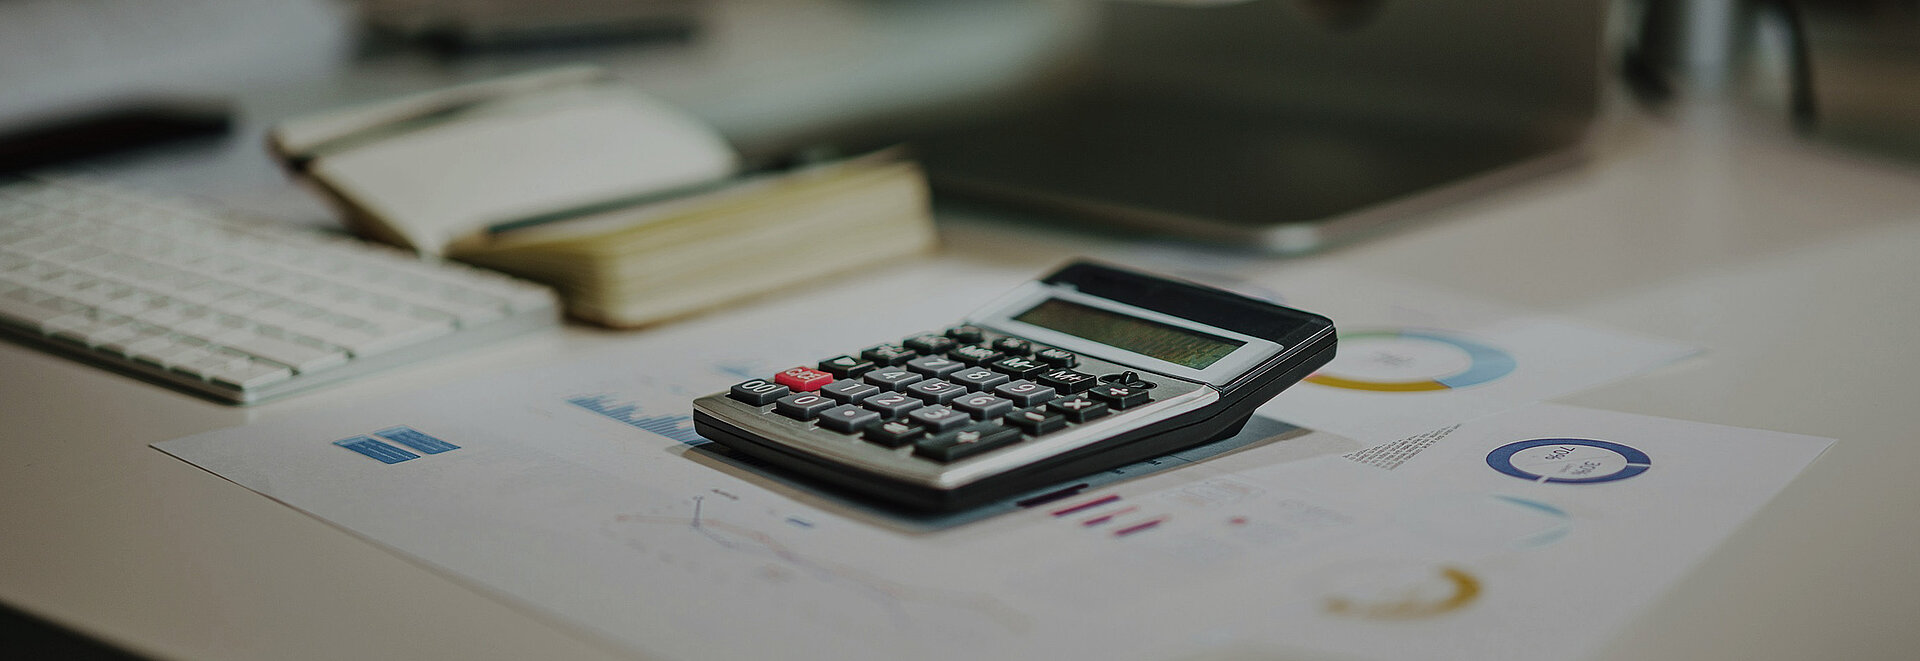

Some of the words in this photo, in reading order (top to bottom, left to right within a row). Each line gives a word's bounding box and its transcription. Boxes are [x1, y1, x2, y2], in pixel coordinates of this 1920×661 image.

[882, 371, 906, 380] 4
[966, 371, 991, 380] 8
[741, 380, 777, 393] 00
[840, 383, 861, 392] 1
[923, 382, 950, 391] 5
[1010, 384, 1036, 392] 9
[794, 396, 819, 405] 0
[877, 395, 904, 406] 2
[969, 396, 995, 405] 6
[924, 408, 951, 419] 3
[1545, 446, 1575, 460] 70%
